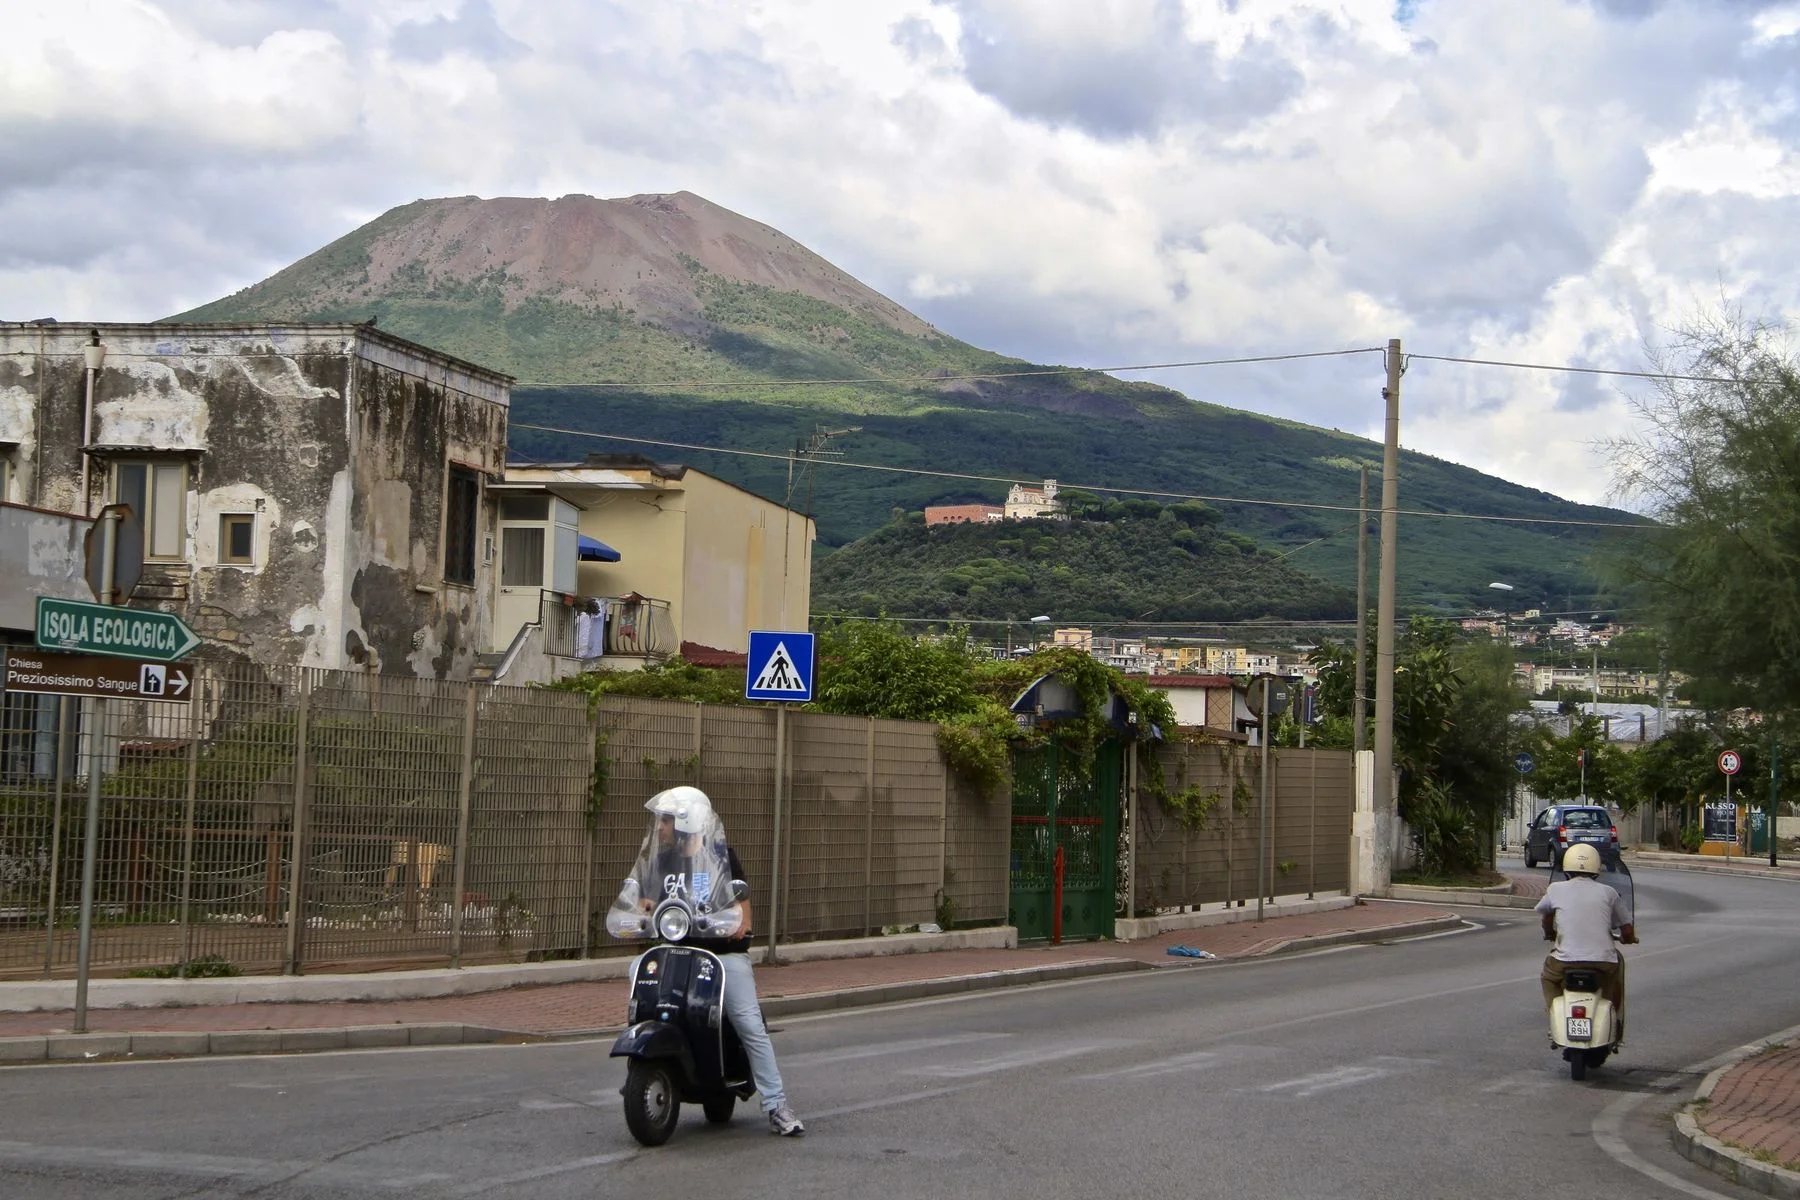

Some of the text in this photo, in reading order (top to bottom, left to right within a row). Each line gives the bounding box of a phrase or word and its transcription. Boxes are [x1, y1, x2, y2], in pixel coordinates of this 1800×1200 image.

[44, 611, 176, 651] ISOLA ECOLOGICA
[8, 658, 43, 669] Chiesa
[8, 671, 138, 692] Preziosissimo Sangue
